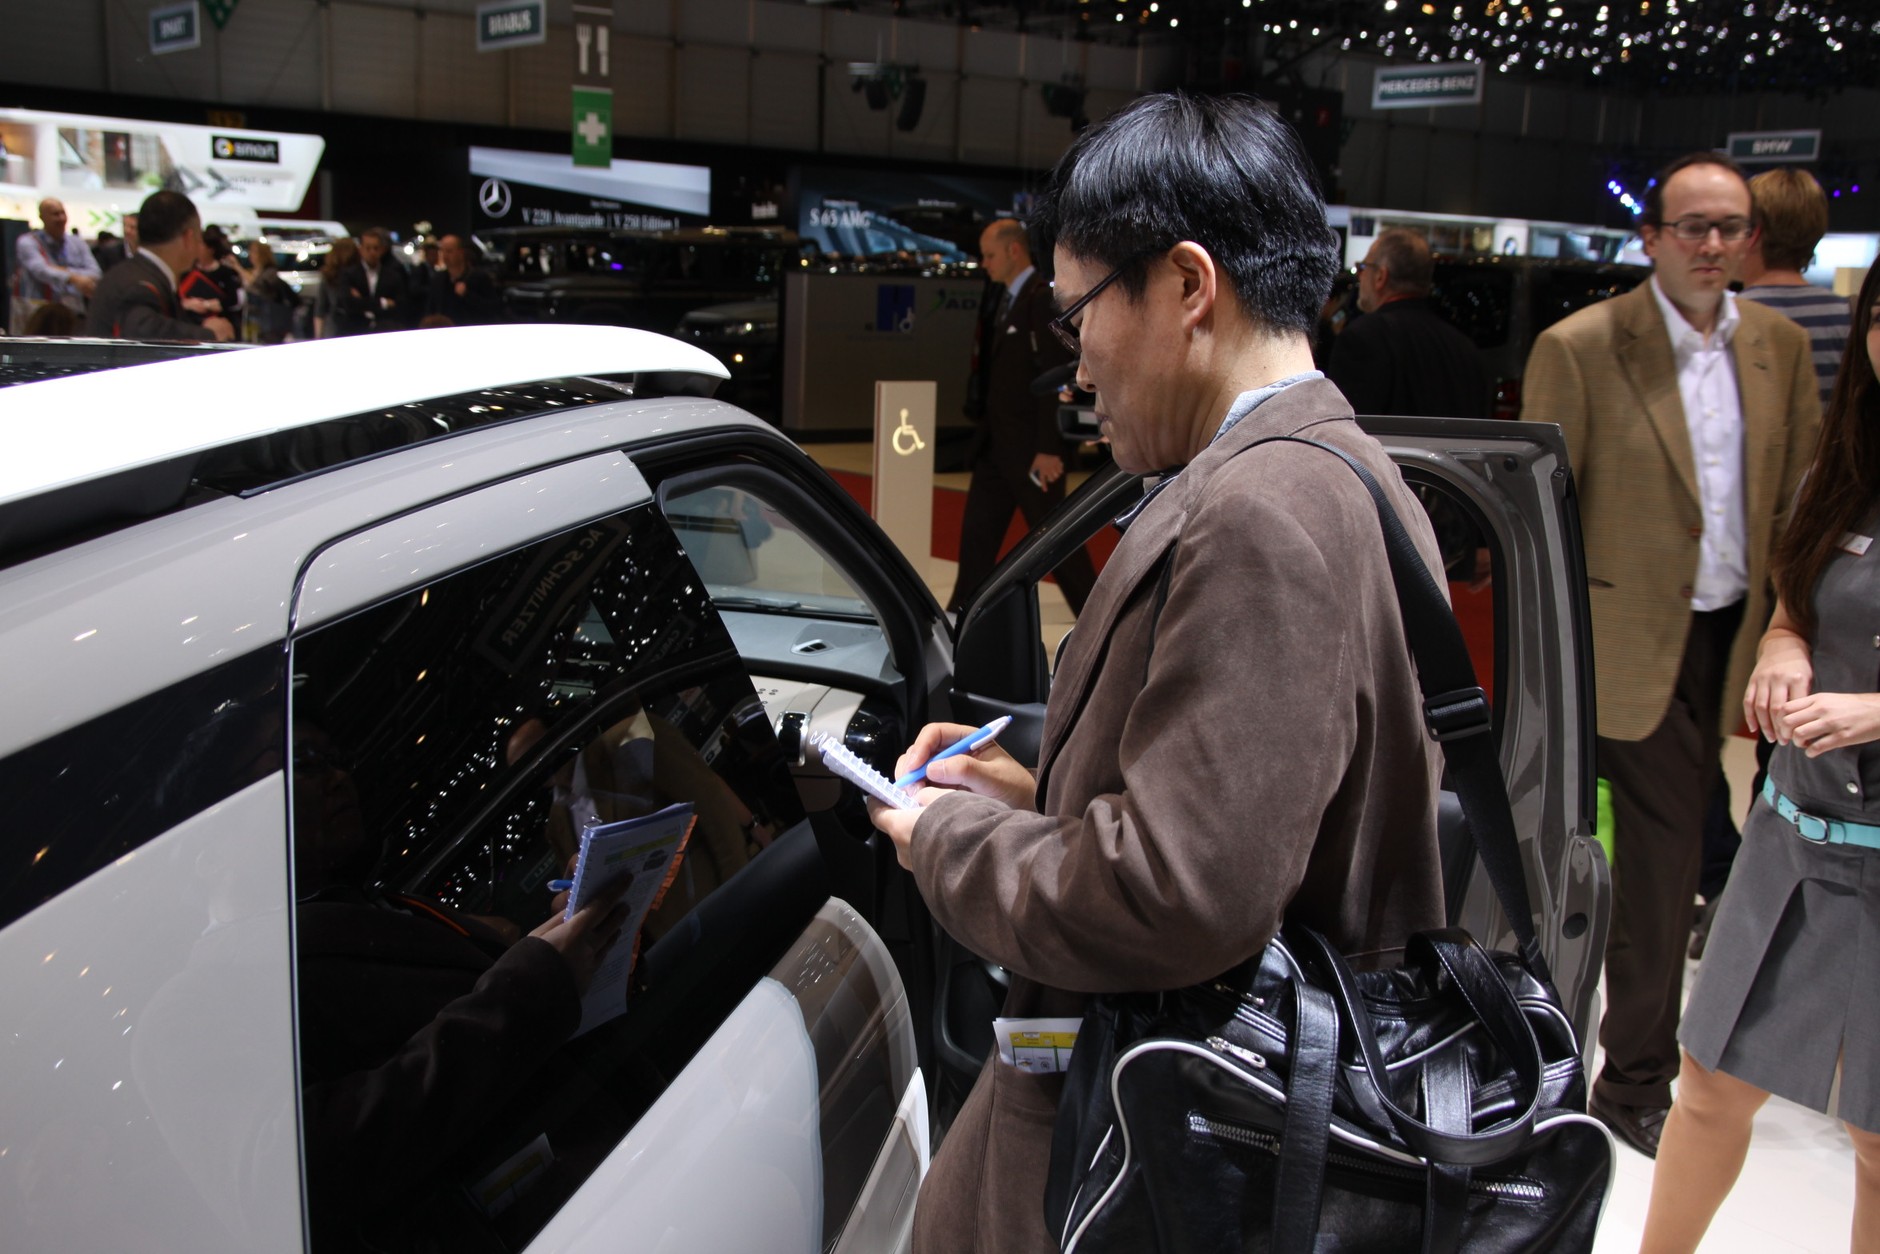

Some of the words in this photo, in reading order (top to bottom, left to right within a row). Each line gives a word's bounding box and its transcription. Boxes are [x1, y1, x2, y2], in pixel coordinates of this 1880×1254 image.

[234, 141, 276, 159] smart
[1751, 138, 1793, 154] BMW
[521, 207, 530, 224] V
[533, 207, 551, 225] 220
[554, 210, 605, 228] Avantgarde
[614, 213, 622, 228] V
[641, 214, 672, 231] Edition
[809, 207, 820, 227] S
[821, 208, 838, 229] 65
[840, 209, 871, 229] AMG
